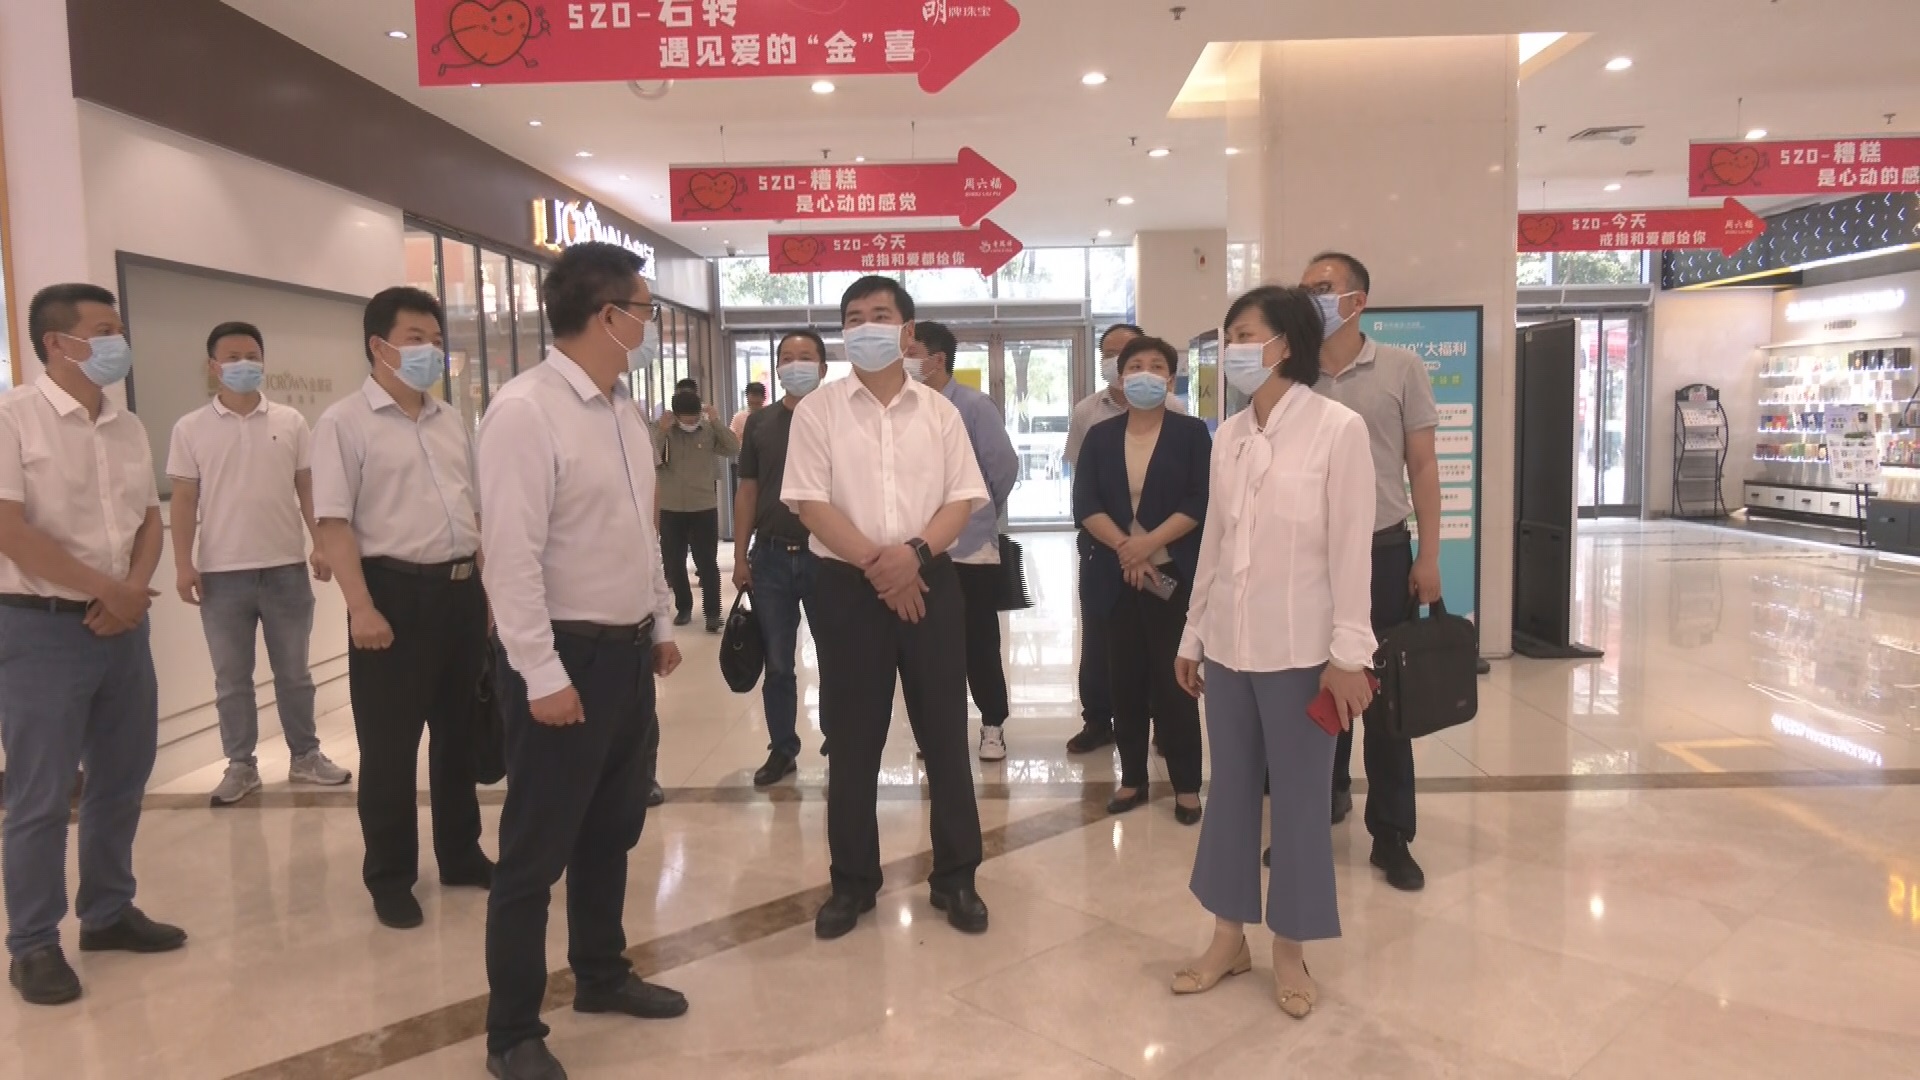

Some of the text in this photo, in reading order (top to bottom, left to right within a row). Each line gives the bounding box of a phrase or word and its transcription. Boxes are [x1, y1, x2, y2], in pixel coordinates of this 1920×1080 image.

[1780, 141, 1881, 165] 520-糟糕
[758, 168, 857, 191] 520-糟糕
[1817, 166, 1920, 187] 是心动的感
[796, 193, 917, 213] 是心动的感觉
[1572, 213, 1647, 231] 520-今天
[834, 234, 906, 251] 520-今天
[1600, 230, 1706, 247] 戒指和爱都给你
[861, 251, 965, 268] 戒指和爱都给你
